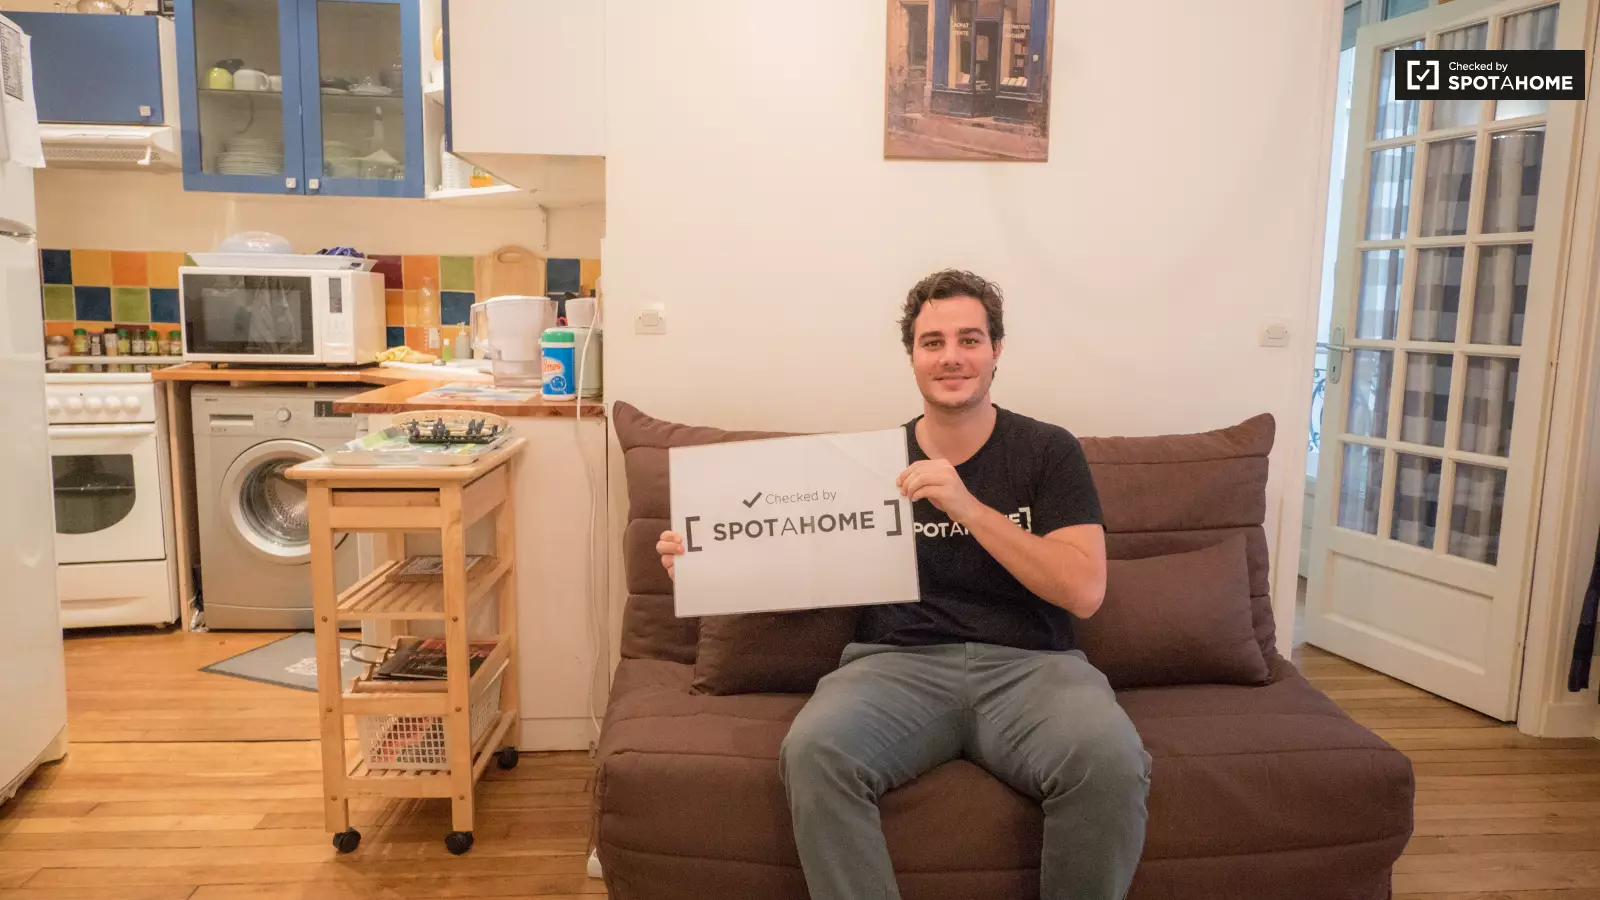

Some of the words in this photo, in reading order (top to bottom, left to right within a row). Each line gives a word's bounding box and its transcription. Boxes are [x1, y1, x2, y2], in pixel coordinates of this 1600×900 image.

[765, 490, 819, 505] Checked
[823, 489, 837, 502] by
[713, 510, 876, 541] SPOTAHOME
